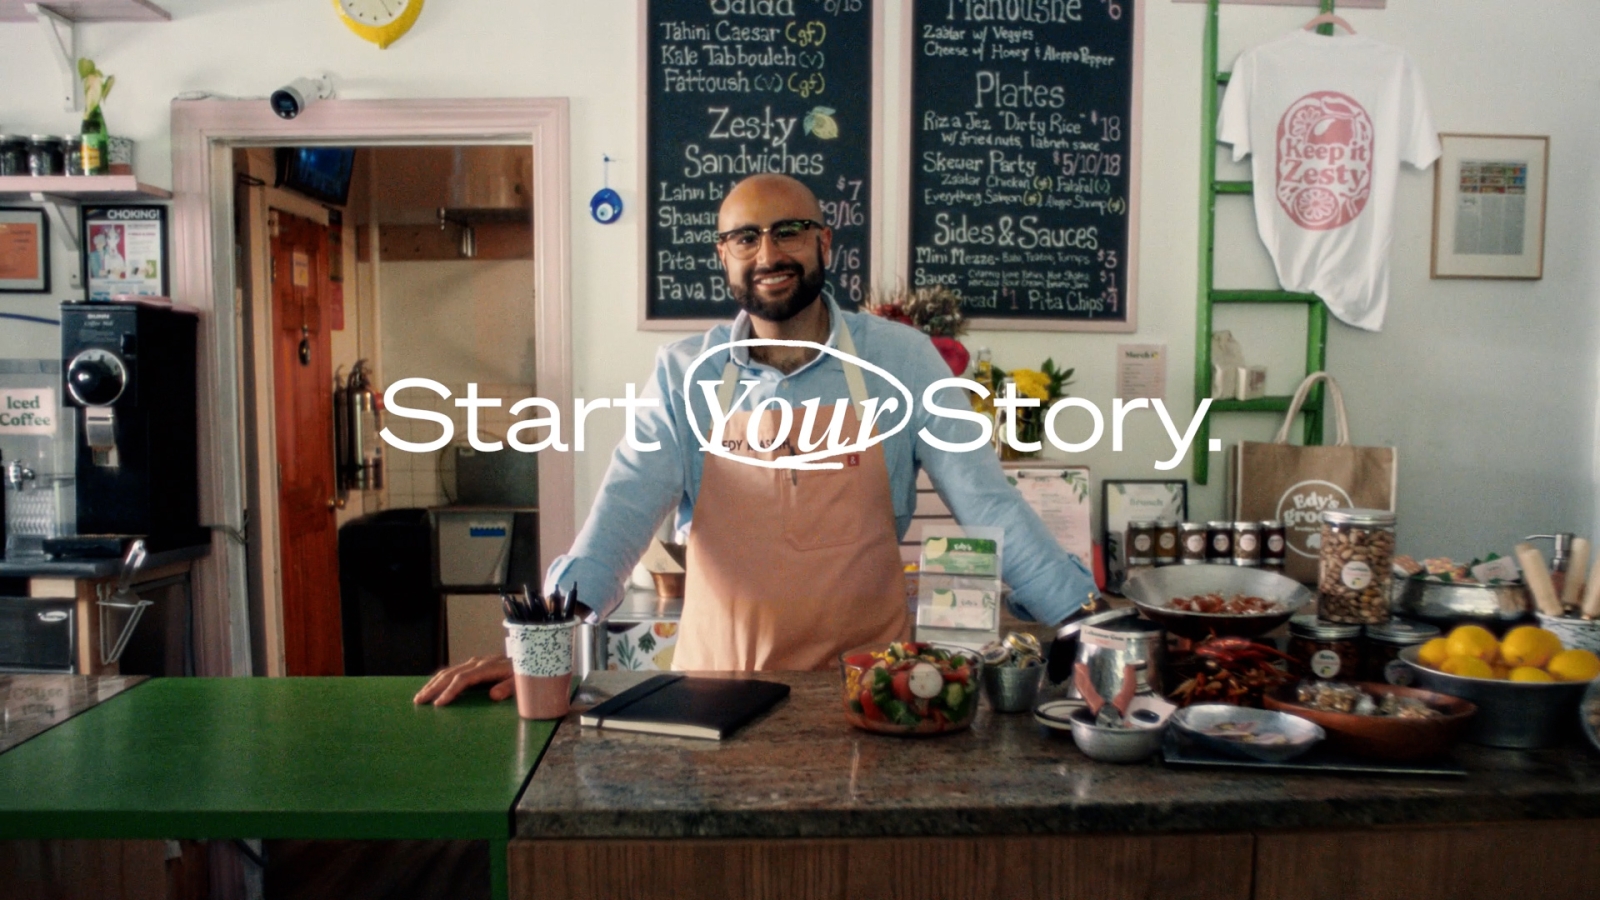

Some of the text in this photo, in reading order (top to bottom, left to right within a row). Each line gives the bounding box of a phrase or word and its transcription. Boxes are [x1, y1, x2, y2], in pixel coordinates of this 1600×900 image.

[660, 20, 826, 47] Tahini Caesar (gf)
[973, 26, 988, 42] w/
[993, 26, 1034, 43] Veggies
[661, 46, 698, 66] Kale
[703, 45, 797, 66] Tabbouleh
[924, 41, 968, 57] Cheese
[991, 45, 1029, 62] Honey
[1043, 45, 1079, 63] Aleppo
[1080, 47, 1114, 68] Pepper
[664, 69, 750, 92] Fattoush
[788, 72, 826, 98] (gf)
[975, 71, 1065, 108] Plates
[708, 106, 797, 147] Zesty
[966, 112, 991, 130] Jez
[959, 131, 992, 146] fried
[1072, 141, 1100, 151] sauce
[1285, 138, 1367, 165] Keep it
[684, 143, 824, 178] Sandwiches
[922, 151, 983, 172] Skewer
[990, 150, 1037, 178] Party
[986, 175, 1030, 190] Chicken
[1056, 176, 1093, 194] Falafel
[1283, 160, 1367, 193] Zesty
[660, 182, 705, 201] Lahm
[709, 181, 724, 200] bi
[836, 175, 862, 201] $7
[924, 188, 982, 206] Everything
[107, 209, 160, 219] CHOKING!
[658, 205, 719, 227] Shawar
[671, 226, 720, 244] Lavas
[934, 213, 1098, 250] Sides & Sauces
[658, 250, 723, 272] Pita-di
[916, 247, 948, 263] Mini
[1097, 249, 1117, 269] $3
[657, 275, 706, 300] Fava
[840, 274, 862, 302] $8
[1028, 290, 1063, 310] Pita
[1066, 291, 1104, 318] Chips
[7, 395, 40, 409] Iced
[0, 411, 51, 427] Coffee
[1293, 491, 1340, 510] Edy's
[1283, 508, 1324, 527] gro
